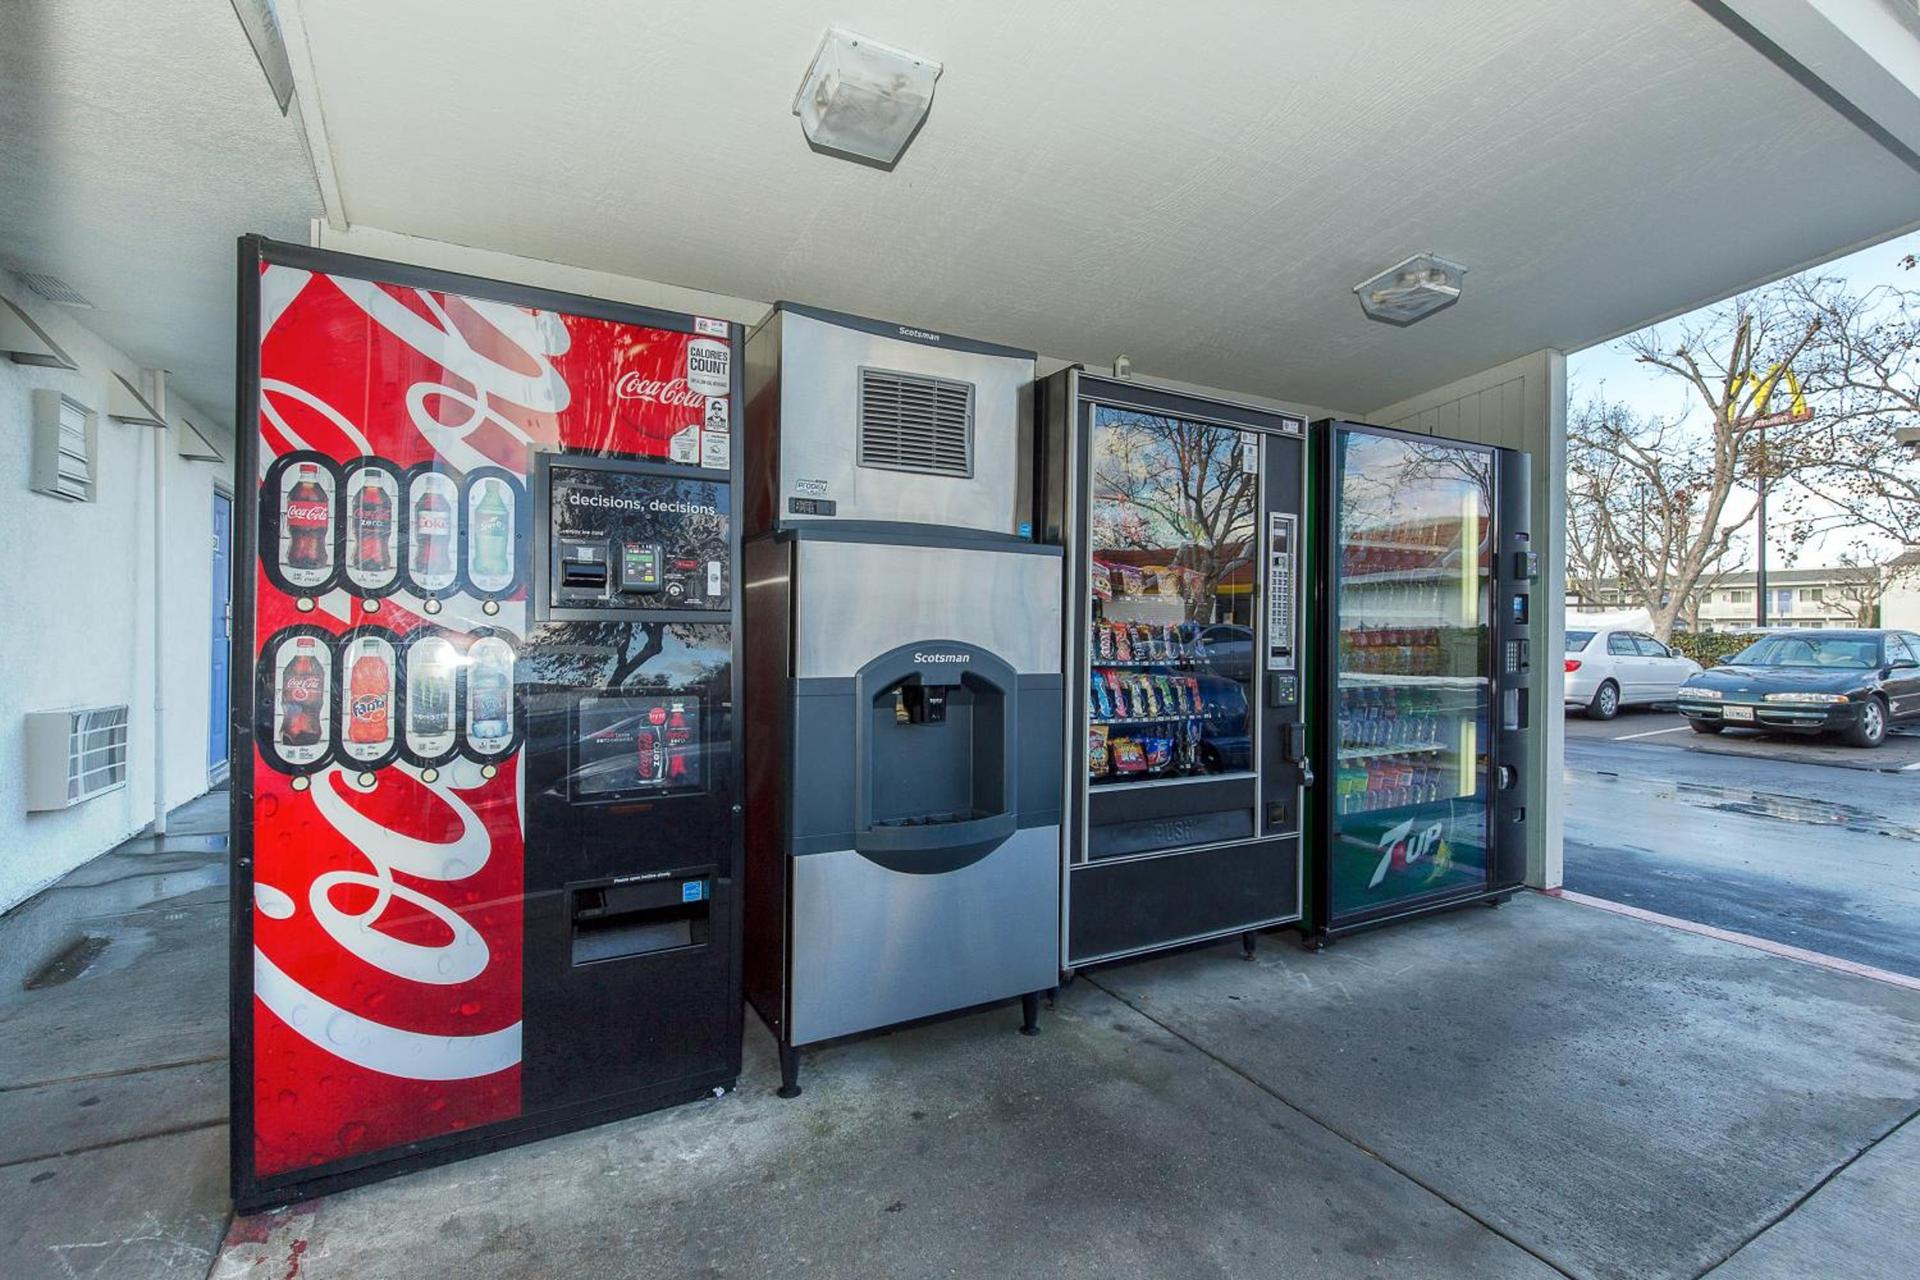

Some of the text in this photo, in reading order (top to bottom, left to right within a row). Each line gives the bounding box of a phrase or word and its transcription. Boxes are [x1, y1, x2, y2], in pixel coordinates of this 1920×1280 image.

[899, 327, 940, 342] Scotsman
[690, 346, 728, 362] CALORIES
[690, 358, 728, 376] COUNT
[616, 371, 704, 409] Coca-Cola
[287, 505, 328, 521] Coca-Cola
[569, 493, 716, 517] decisions, decisions
[913, 652, 970, 664] Scotsman
[1367, 817, 1443, 889] 7UP
